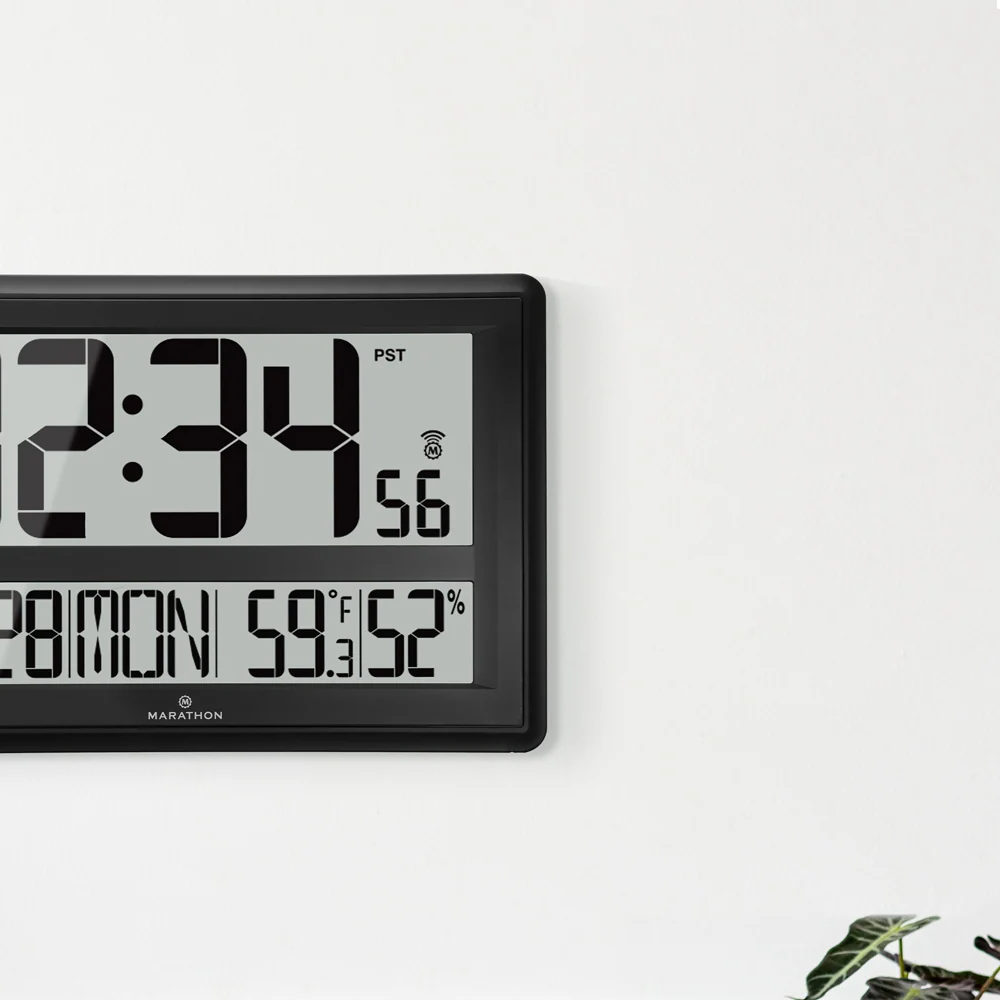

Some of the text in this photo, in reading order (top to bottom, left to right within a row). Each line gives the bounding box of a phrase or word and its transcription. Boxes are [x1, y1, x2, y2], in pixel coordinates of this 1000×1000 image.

[374, 348, 407, 362] PST
[376, 469, 450, 538] 56
[76, 589, 210, 679] MON
[147, 711, 223, 720] MARATHON
